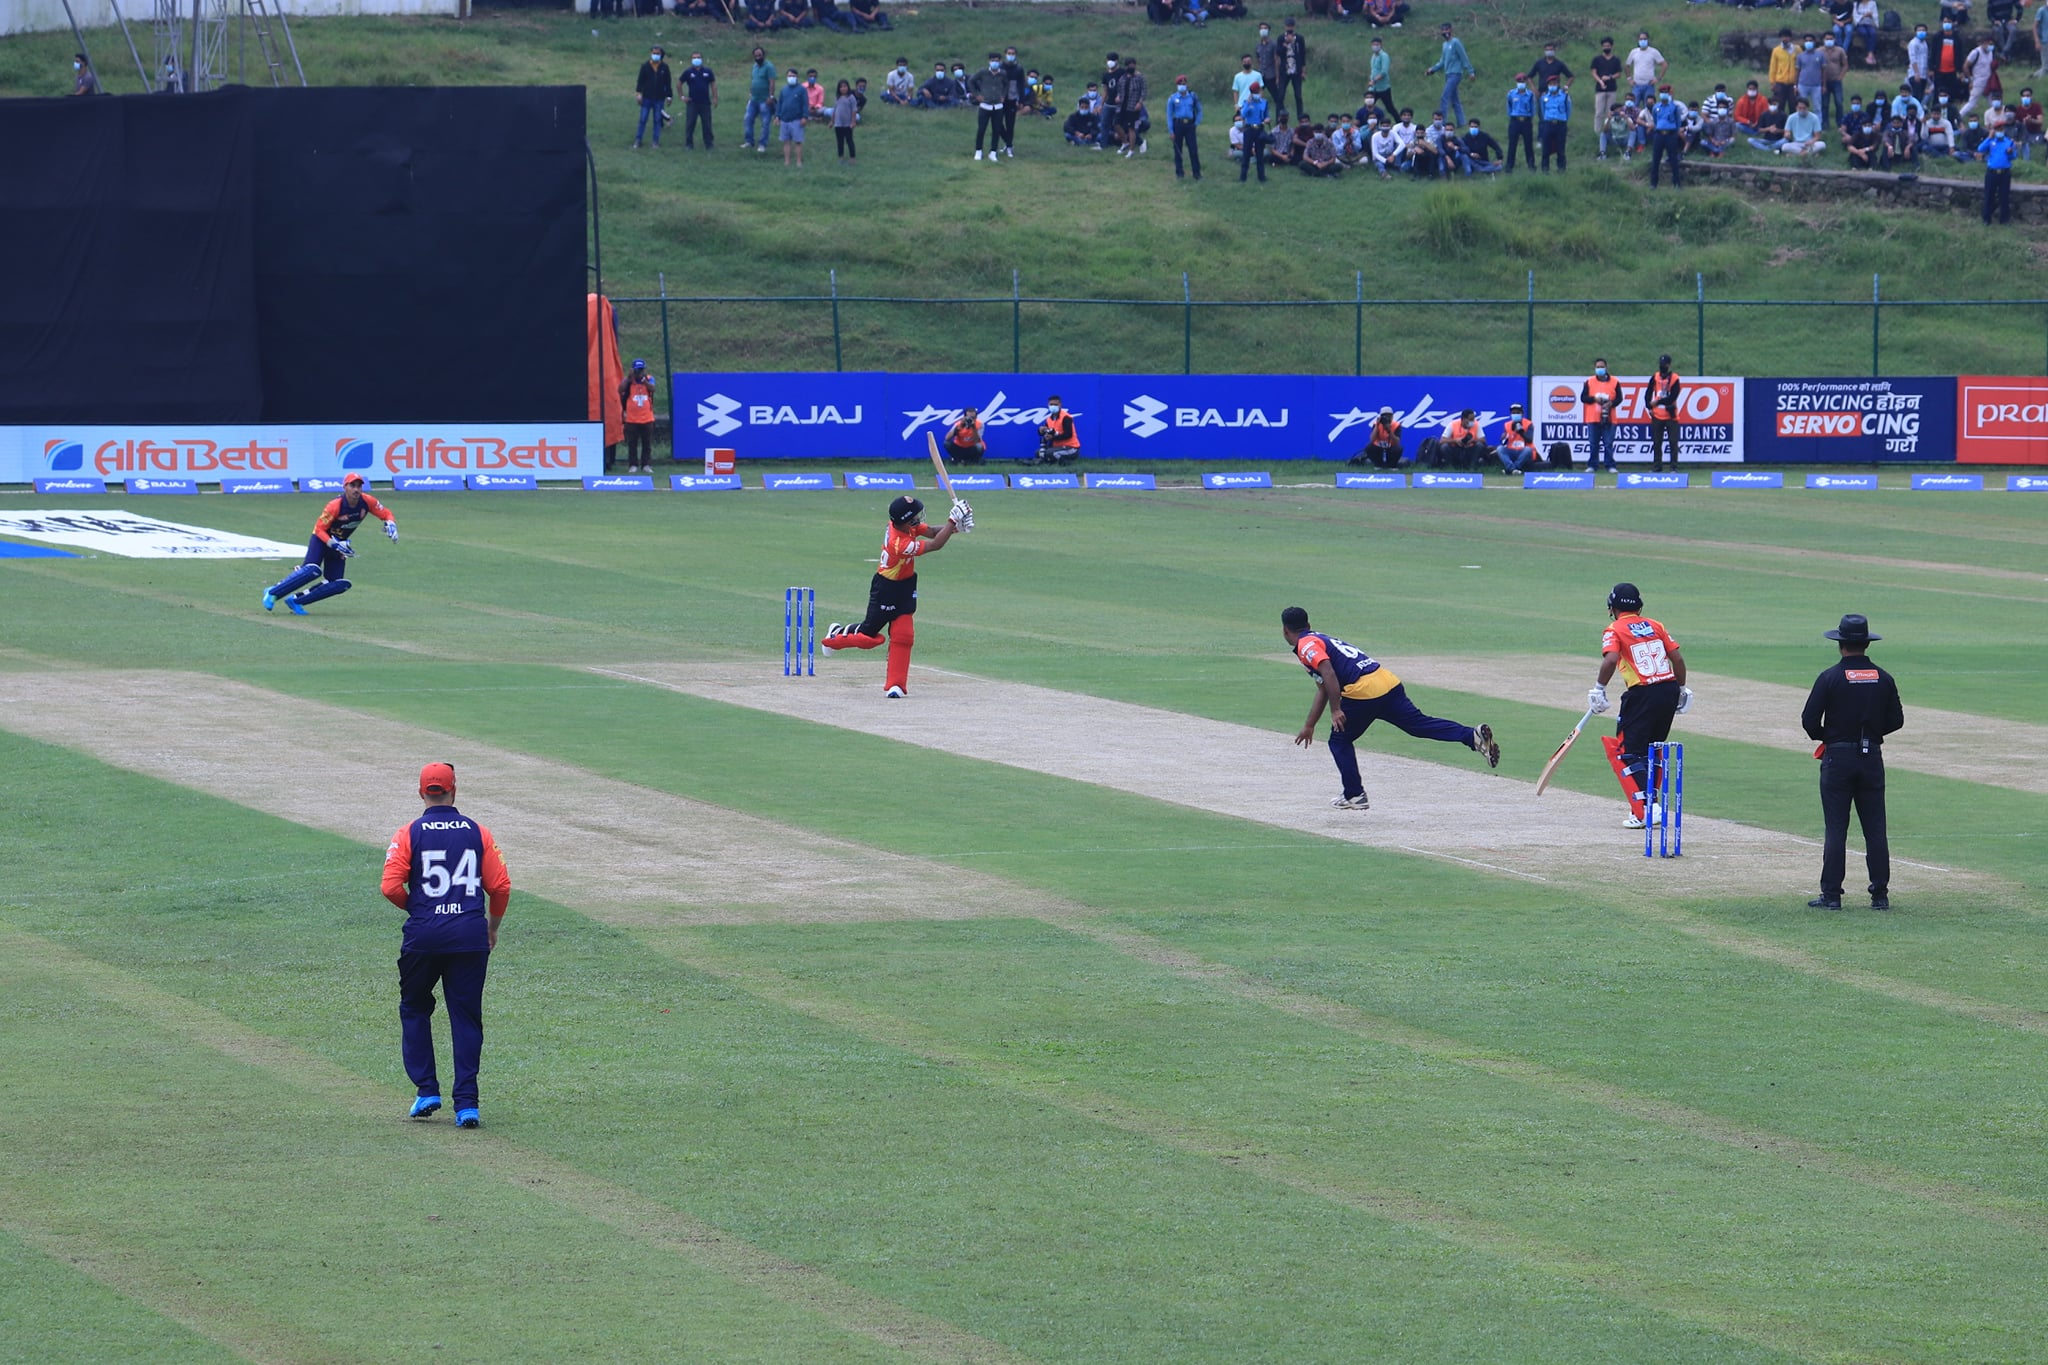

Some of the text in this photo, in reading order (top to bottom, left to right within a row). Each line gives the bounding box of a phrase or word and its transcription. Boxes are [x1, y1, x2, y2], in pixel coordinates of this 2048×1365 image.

[1777, 383, 1800, 391] 100%
[1801, 383, 1858, 392] Performance
[1777, 395, 1873, 410] SERVICING
[749, 405, 862, 425] BAJAJ
[1175, 408, 1289, 427] BAJAJ
[1780, 413, 1920, 435] SERVO CING
[695, 477, 731, 485] BAJAJ
[422, 821, 471, 830] NOKIA
[421, 849, 481, 898] 54
[435, 903, 464, 914] BURL
